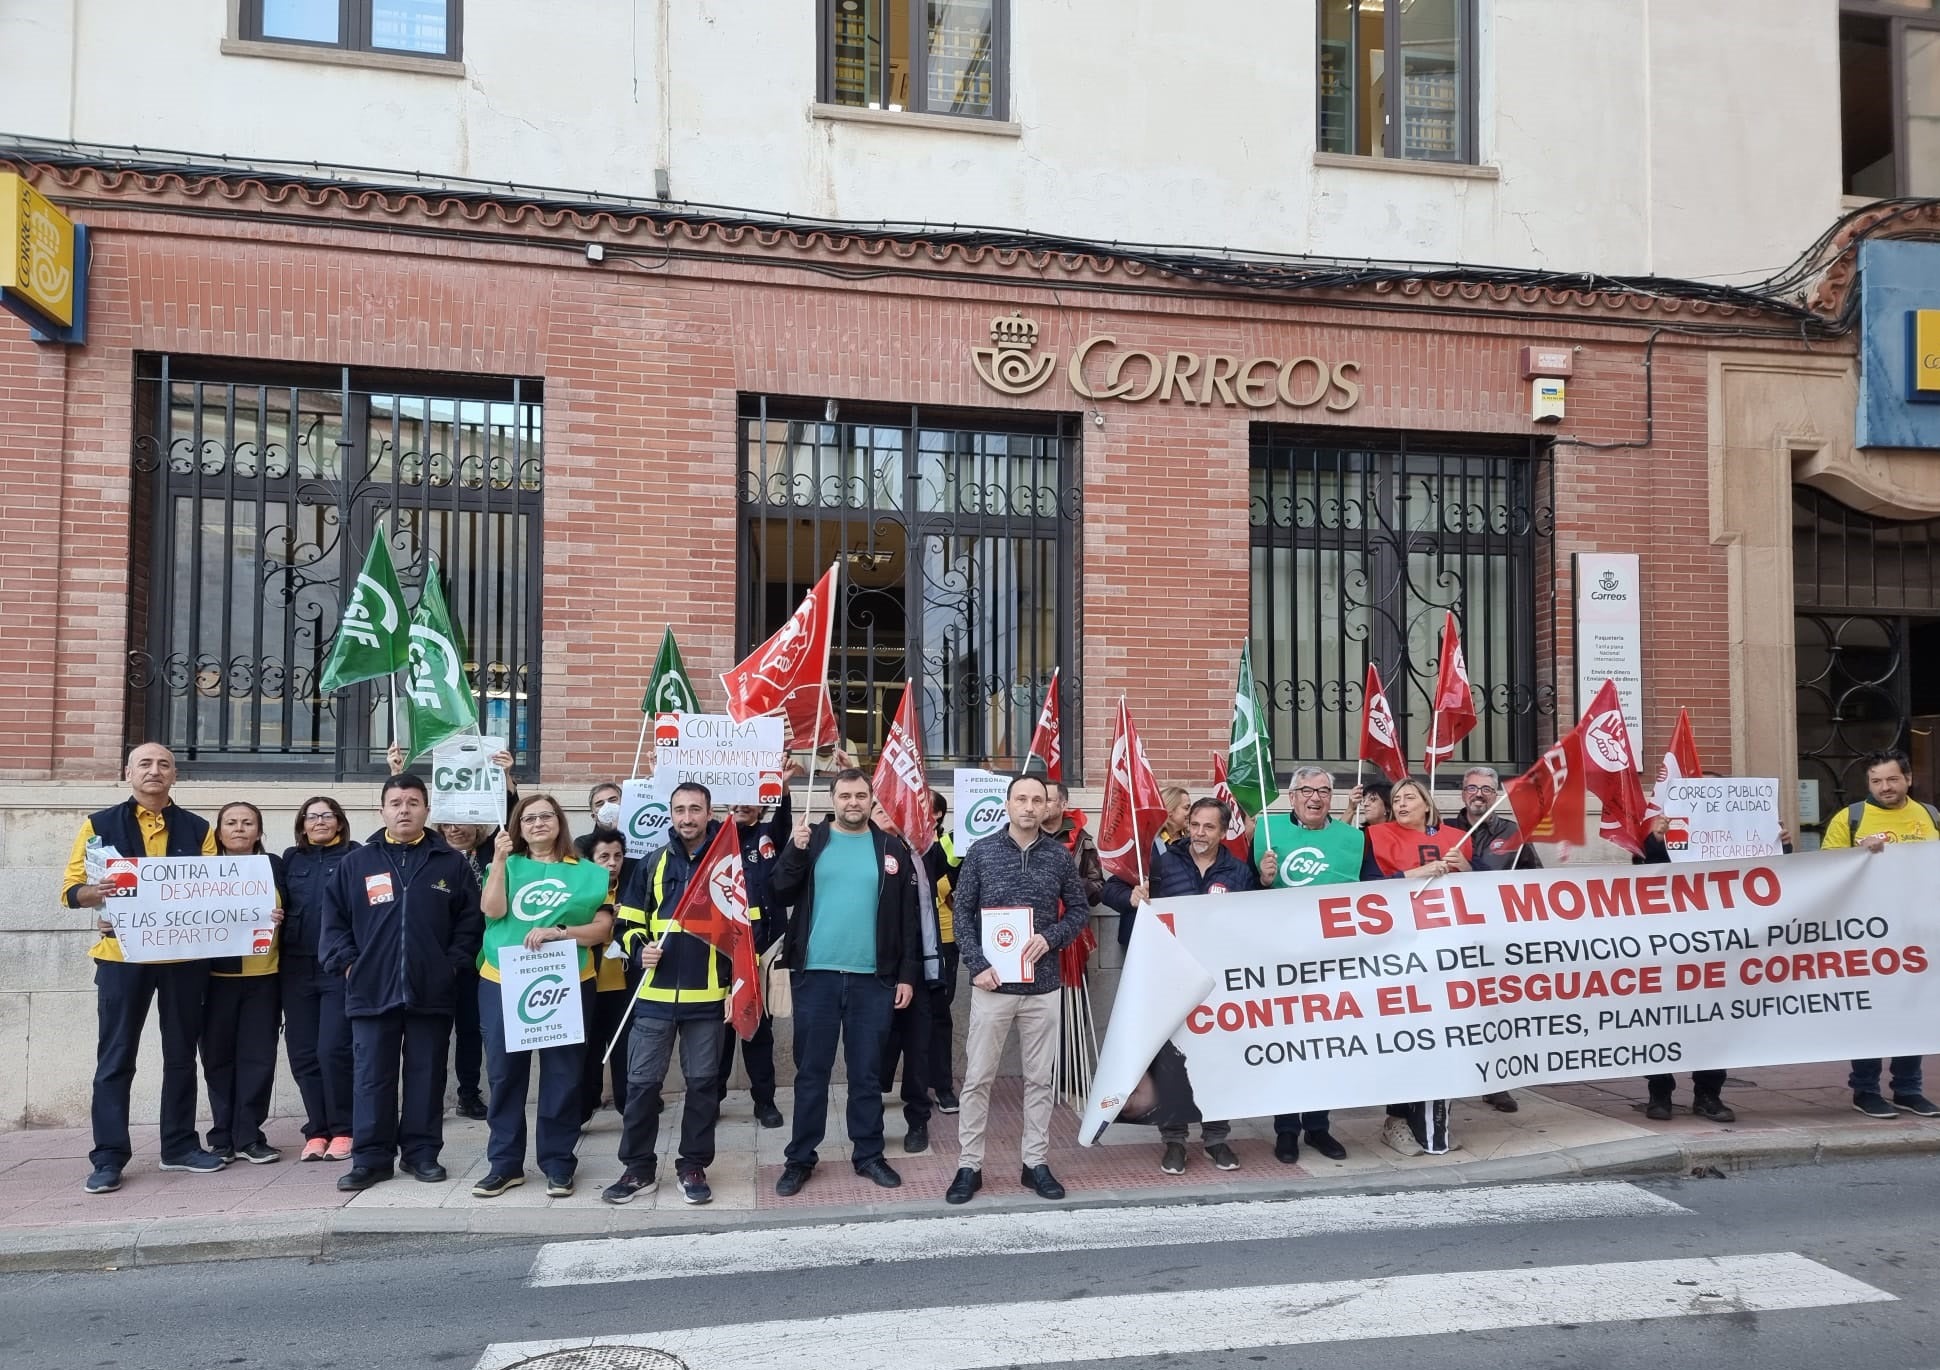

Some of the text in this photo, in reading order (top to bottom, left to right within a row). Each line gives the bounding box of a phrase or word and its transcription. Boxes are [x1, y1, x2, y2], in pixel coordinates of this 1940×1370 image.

[18, 189, 31, 289] CORREOS
[1068, 335, 1361, 412] CORREOS
[1591, 591, 1627, 601] Correos
[685, 719, 758, 739] CONTRA
[656, 738, 678, 747] CGT
[434, 766, 500, 792] CSIF
[677, 770, 755, 787] ENCUBIERTOS
[760, 795, 781, 804] CGT
[1667, 785, 1773, 801] CORREOS PUBLICO
[1689, 800, 1772, 813] Y DE CALIDAD
[637, 813, 671, 829] CSIF
[974, 808, 1007, 823] CSIF
[1690, 829, 1760, 844] CONTRA LA
[1666, 841, 1687, 850] CGT
[1701, 843, 1775, 859] PRECARIEDAD
[140, 862, 240, 882] CONTRA LA
[1289, 856, 1331, 875] CSIF
[160, 880, 268, 901] DESAPARICION
[370, 893, 393, 905] CGT
[523, 890, 574, 908] CSIF
[1318, 866, 1782, 939] ES EL MOMENTO
[132, 911, 157, 928] LAS
[164, 907, 260, 927] SECCIONES
[141, 927, 229, 947] REPARTO
[519, 951, 567, 962] PERSONAL
[1224, 916, 1889, 992] EN DEFENSA DEL SERVICIO POSTAL PÚBLICO
[519, 963, 567, 975] RECORTES
[527, 986, 571, 1008] CSIF
[1185, 945, 1929, 1035] CONTRA EL DESGUACE DE CORREOS
[524, 1023, 563, 1034] POR TUS
[1243, 990, 1873, 1067] CONTRA LOS RECORTES, PLANTILLA SUFICIENTE
[520, 1032, 568, 1045] DERECHOS
[1475, 1041, 1682, 1083] Y CON DERECHOS
